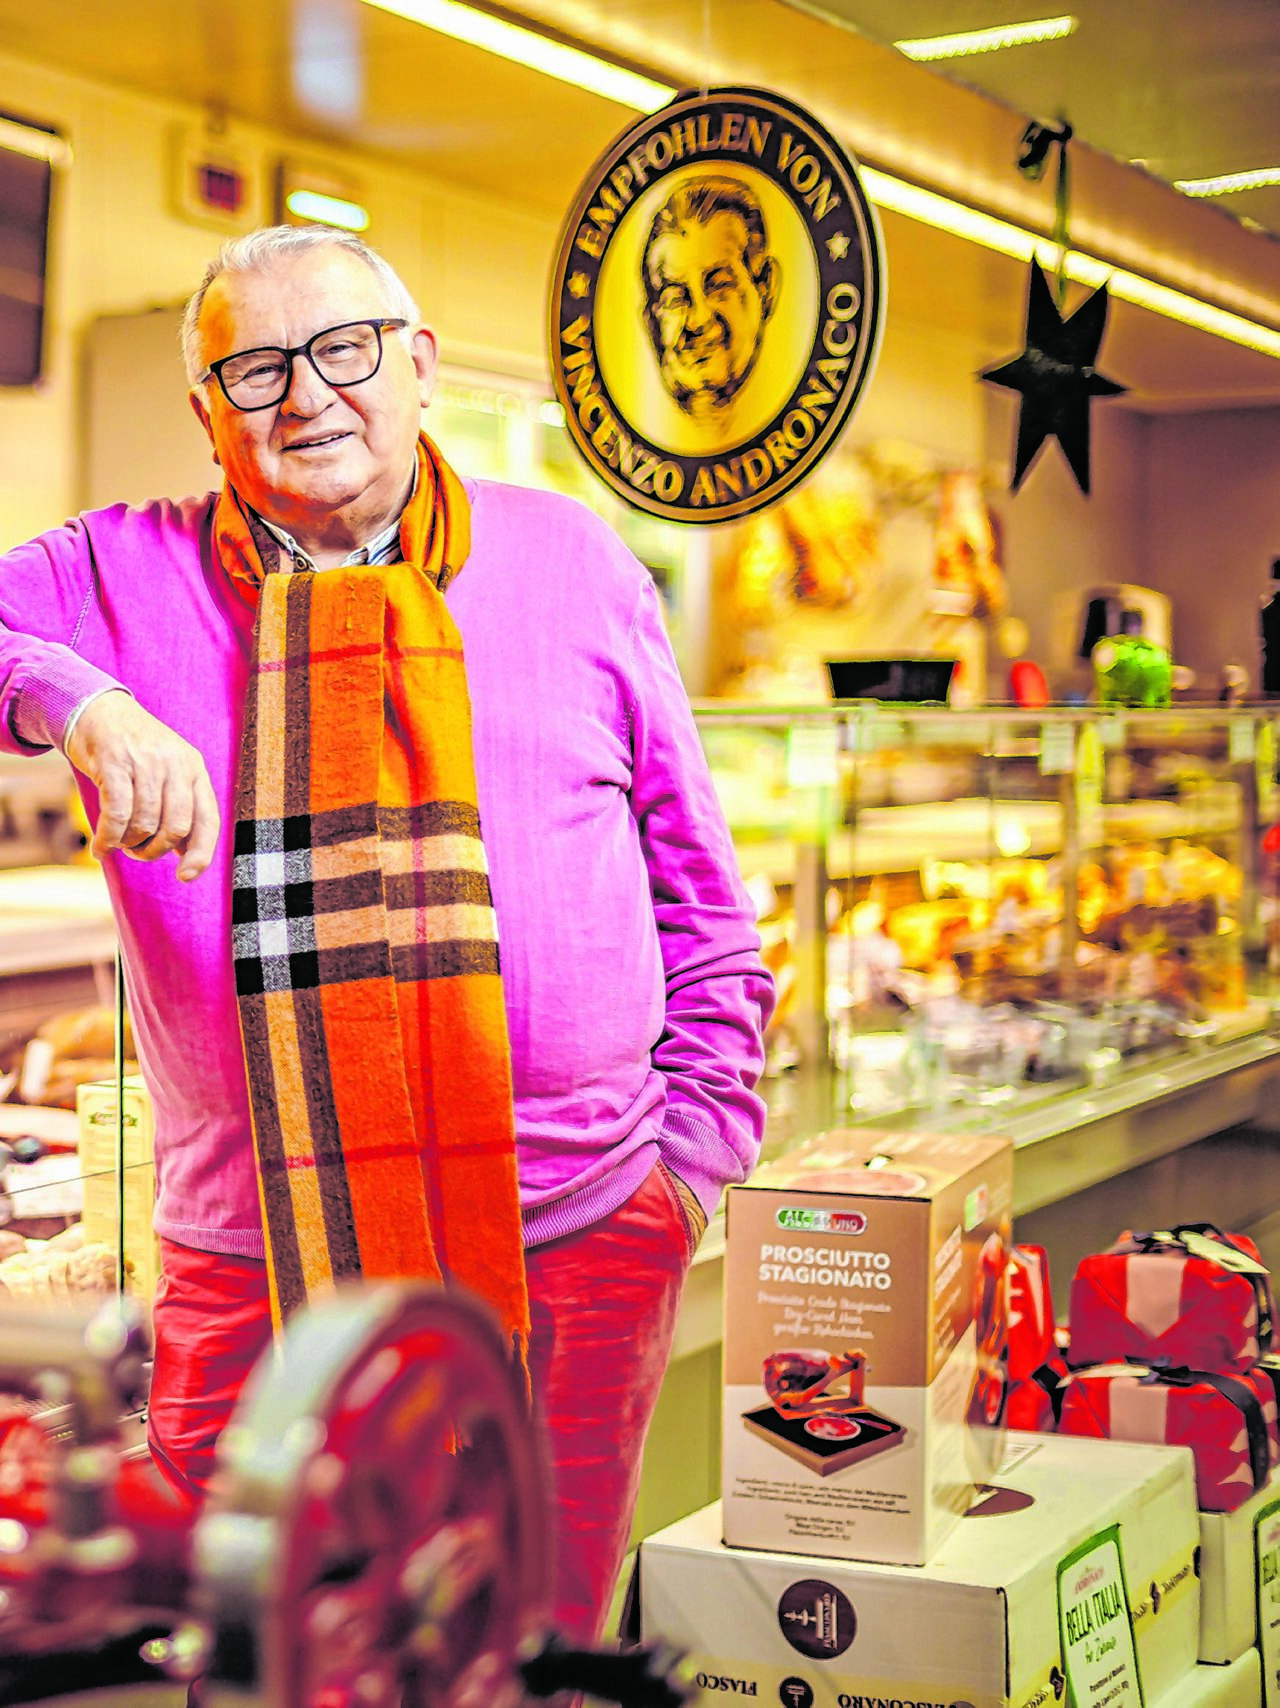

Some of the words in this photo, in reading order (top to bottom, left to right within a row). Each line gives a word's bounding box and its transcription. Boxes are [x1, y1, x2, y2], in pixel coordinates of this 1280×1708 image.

[576, 112, 772, 259] EMPFOHLEN
[778, 132, 842, 222] VON
[561, 316, 685, 501] VINCENZO
[690, 282, 860, 506] ANDRONACO
[758, 1263, 893, 1291] STAGIONATO
[760, 1243, 892, 1271] PROSCIUTTO
[1066, 1599, 1096, 1647] BELLA
[1092, 1581, 1124, 1628] ITALIA
[696, 1672, 757, 1696] FIASCO
